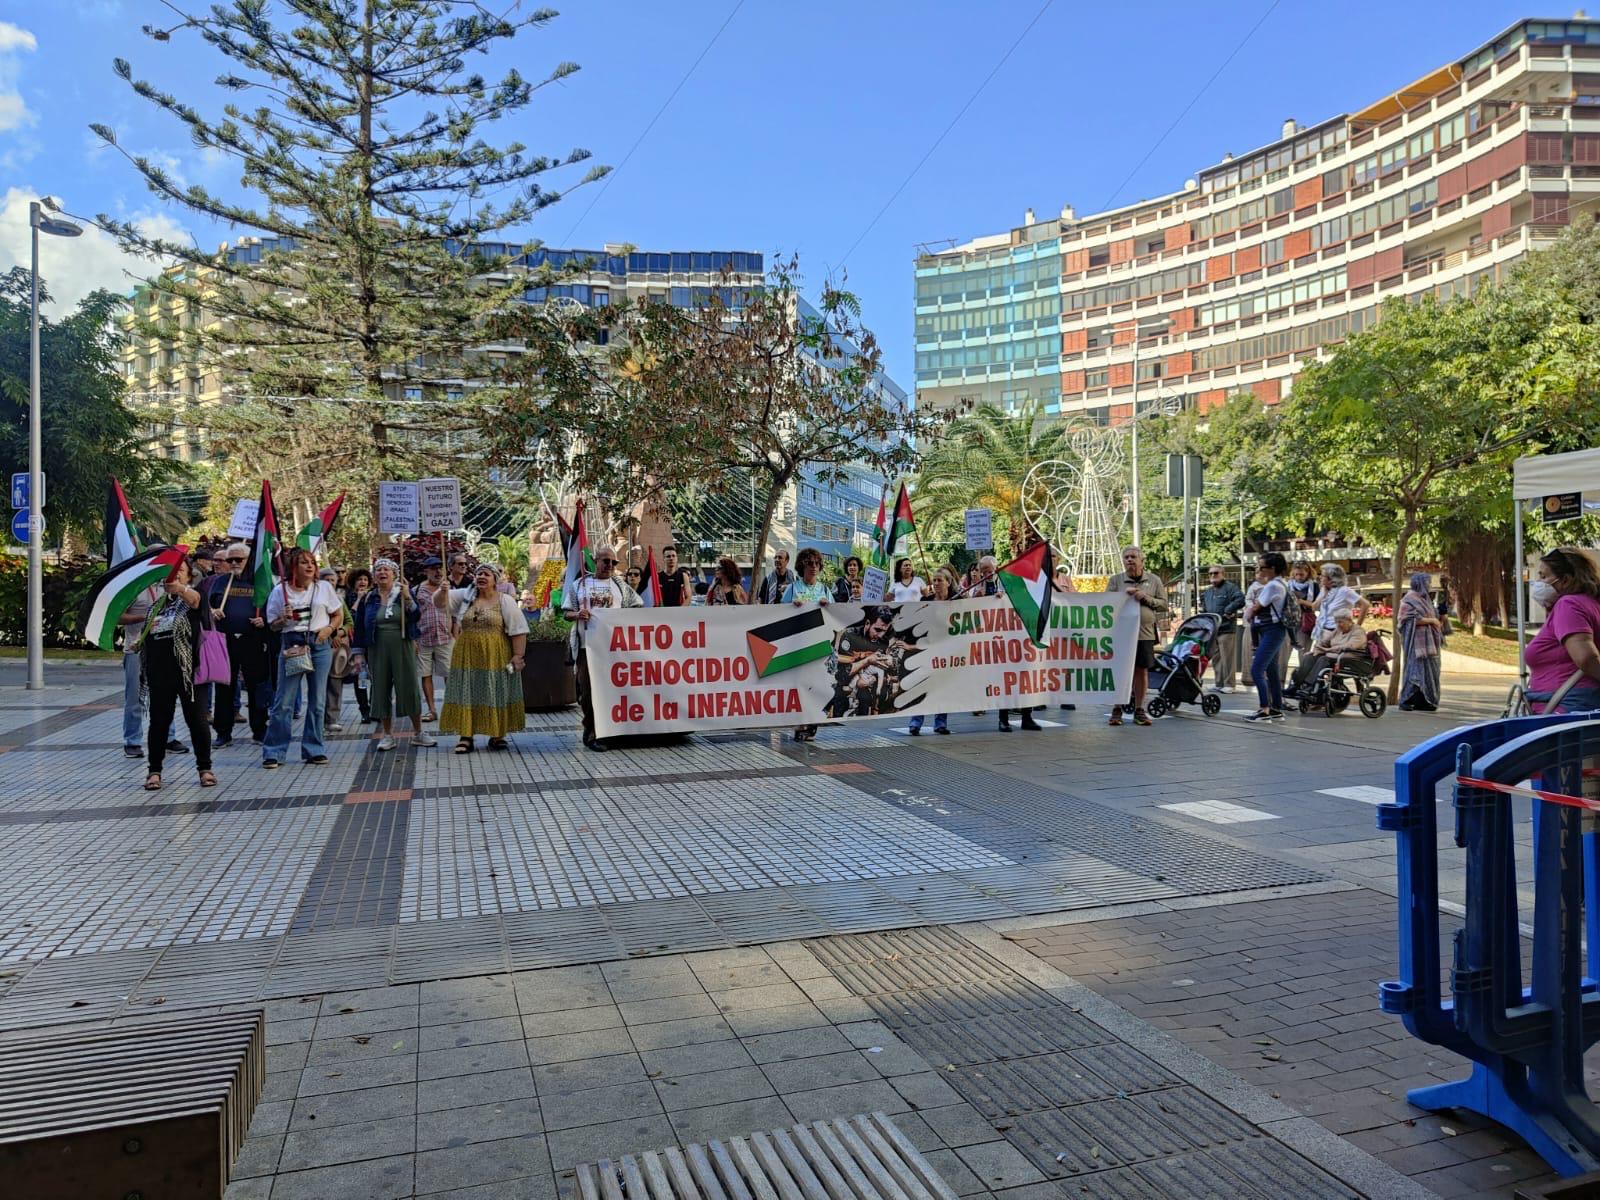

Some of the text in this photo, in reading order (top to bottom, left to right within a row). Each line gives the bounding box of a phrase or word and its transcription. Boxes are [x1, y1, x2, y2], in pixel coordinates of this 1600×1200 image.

[431, 519, 454, 527] GAZA
[948, 605, 1114, 635] SALVAR VIDAS
[609, 621, 706, 652] ALTO al
[932, 656, 947, 669] de
[950, 656, 966, 667] los
[969, 635, 1037, 666] NIÑOS
[1045, 632, 1114, 661] NIÑAS
[610, 656, 750, 688] GENOCIDIO
[985, 668, 1116, 697] de PALESTINA
[611, 688, 802, 723] de la INFANCIA
